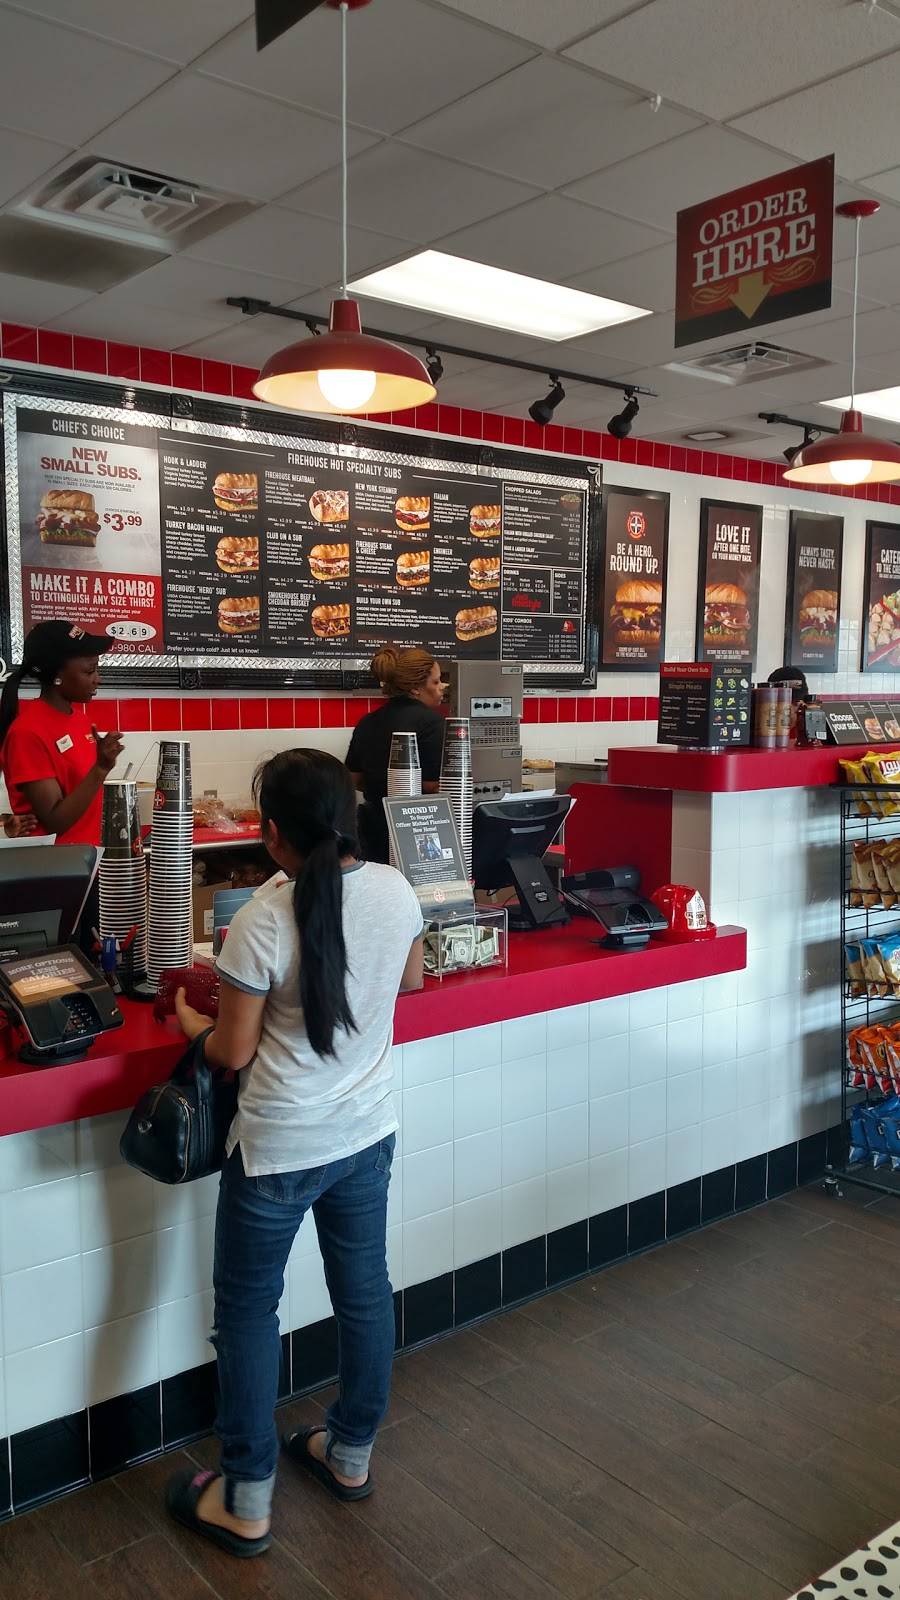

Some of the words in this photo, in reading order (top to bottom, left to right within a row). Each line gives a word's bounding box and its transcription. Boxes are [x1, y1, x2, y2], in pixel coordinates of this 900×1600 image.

[700, 188, 807, 245] ORDER
[692, 214, 816, 288] HERE
[52, 419, 88, 435] CHIEF'S
[91, 425, 124, 440] CHOICE
[72, 447, 108, 462] NEW
[40, 456, 94, 474] SMALL
[97, 464, 142, 480] SUBS.
[164, 456, 179, 464] HOOK
[186, 459, 207, 469] LADDER
[288, 453, 328, 468] FIREHOUSE
[330, 458, 344, 470] HOT
[346, 461, 382, 476] SPECIALTY
[384, 466, 402, 479] SUBS
[265, 470, 290, 480] FIREHOUSE
[103, 513, 142, 531] $3.99
[165, 520, 185, 530] TURKEY
[187, 523, 205, 532] BACON
[206, 525, 224, 534] RANCH
[716, 524, 739, 543] LOVE
[742, 527, 750, 544] IT
[617, 542, 626, 555] BE
[628, 544, 632, 556] A
[635, 545, 653, 558] HERO.
[714, 542, 728, 552] AFTER
[729, 544, 739, 553] ONE
[800, 546, 819, 557] ALWAYS
[610, 554, 642, 573] ROUND
[646, 558, 659, 574] UP.
[799, 556, 817, 568] NEVER
[883, 563, 891, 574] THE
[30, 573, 71, 592] MAKE
[76, 576, 88, 593] IT
[94, 578, 103, 595] A
[108, 578, 155, 598] COMBO
[167, 584, 195, 593] FIREHOUSE
[196, 586, 214, 594] "HERO"
[30, 591, 40, 601] TO
[44, 592, 89, 604] EXTINGUISH
[93, 595, 108, 605] ANY
[111, 596, 127, 606] SIZE
[129, 597, 156, 608] THIRST.
[138, 644, 156, 653] CAL
[830, 713, 854, 721] Choose
[832, 723, 847, 732] your
[402, 806, 428, 815] ROUND
[8, 964, 34, 976] MORE
[35, 958, 74, 967] OPTIONS
[31, 966, 58, 976] LESS
